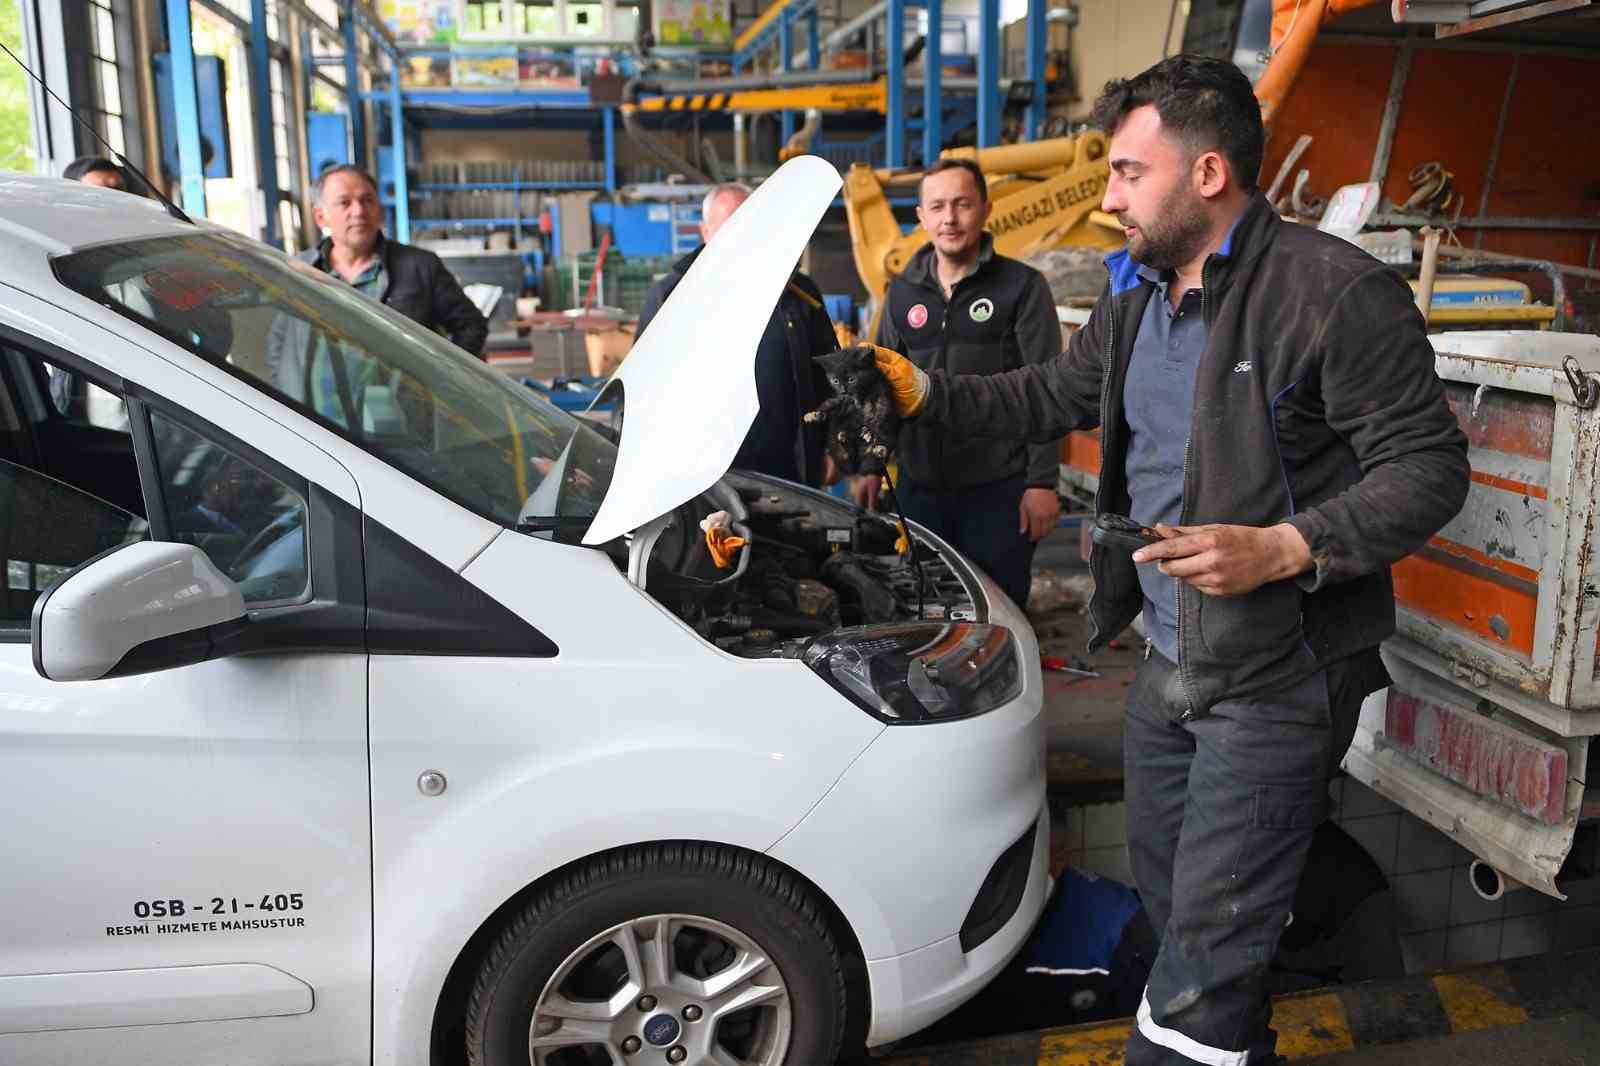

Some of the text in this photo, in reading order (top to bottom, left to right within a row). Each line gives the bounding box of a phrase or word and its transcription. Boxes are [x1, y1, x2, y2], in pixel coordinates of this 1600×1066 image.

[133, 899, 186, 918] OSB
[157, 921, 218, 934] HIZMETE
[221, 918, 305, 931] MAHSUSTUR
